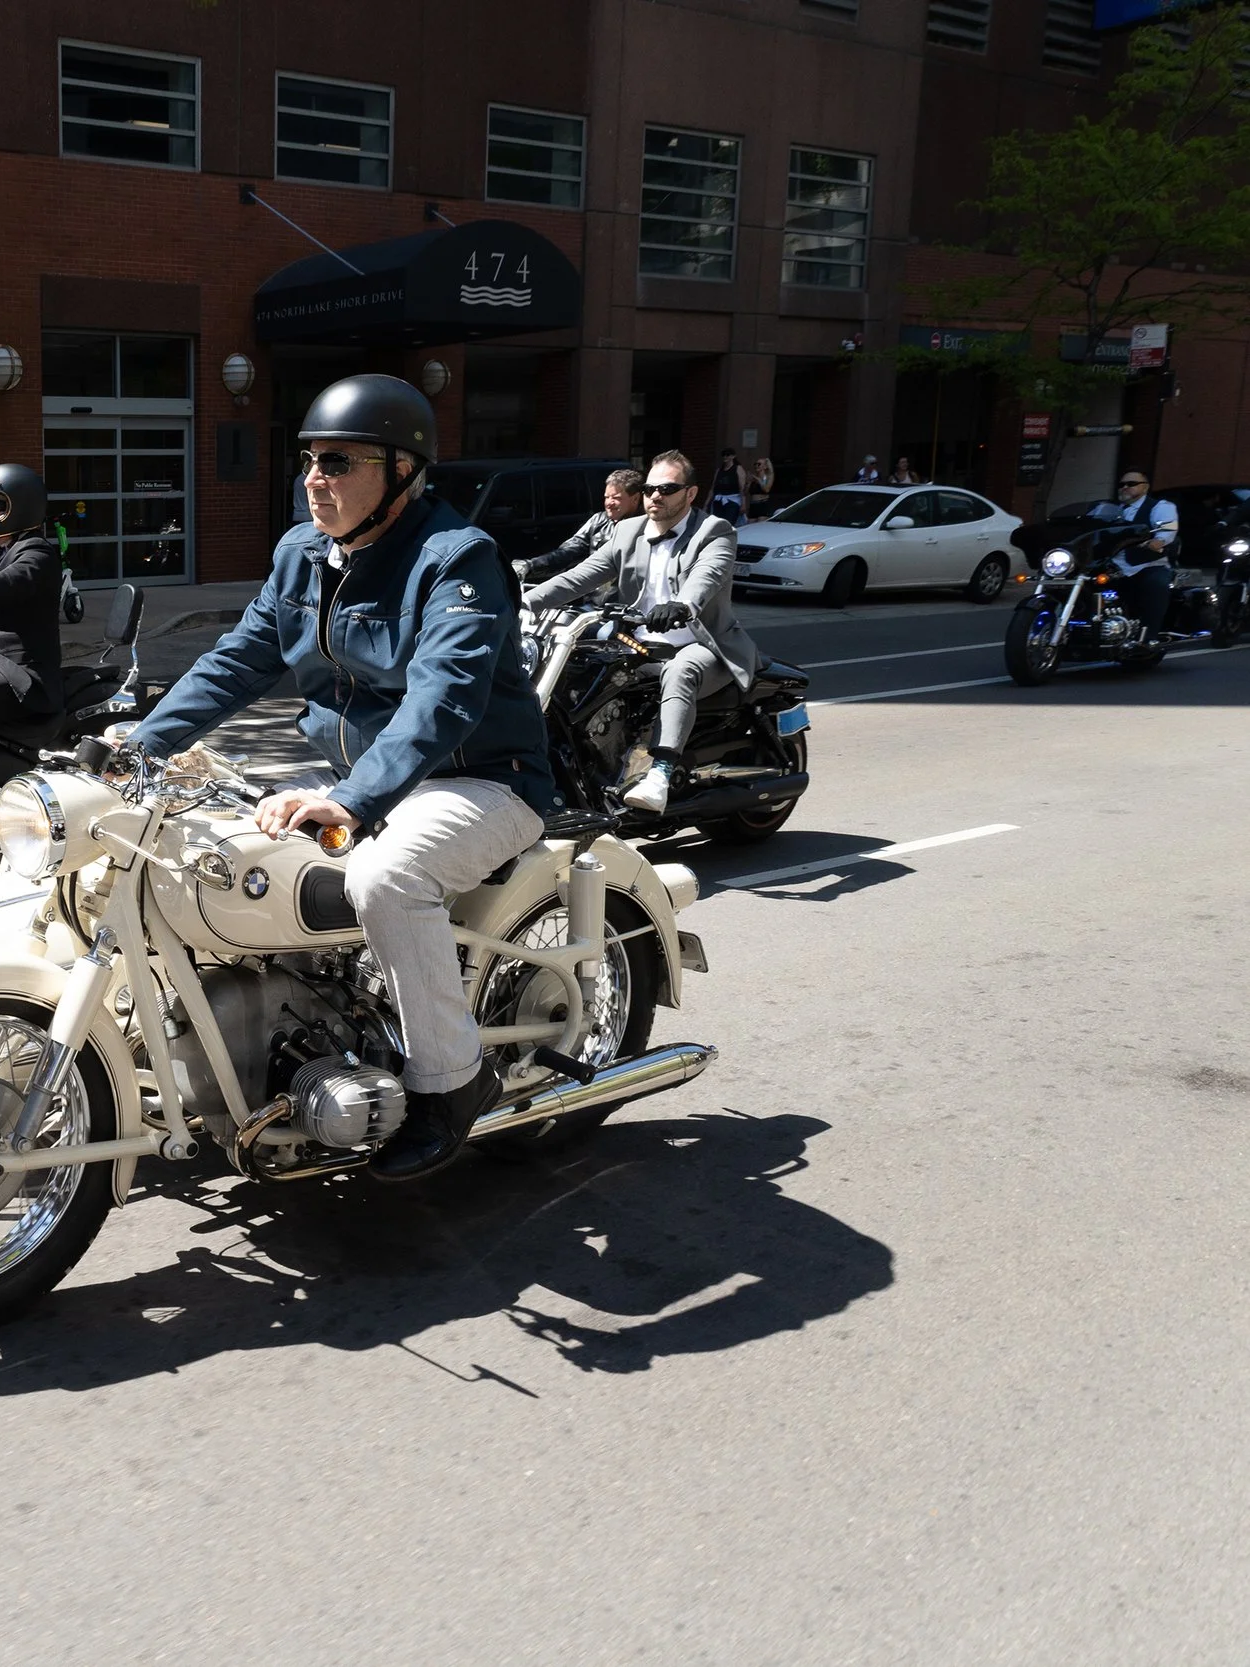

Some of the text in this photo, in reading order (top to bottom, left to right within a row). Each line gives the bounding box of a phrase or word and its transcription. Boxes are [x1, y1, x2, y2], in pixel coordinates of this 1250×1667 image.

[463, 249, 531, 284] 474
[256, 288, 405, 322] 474 NORTH LAKE SHORE DRIVE
